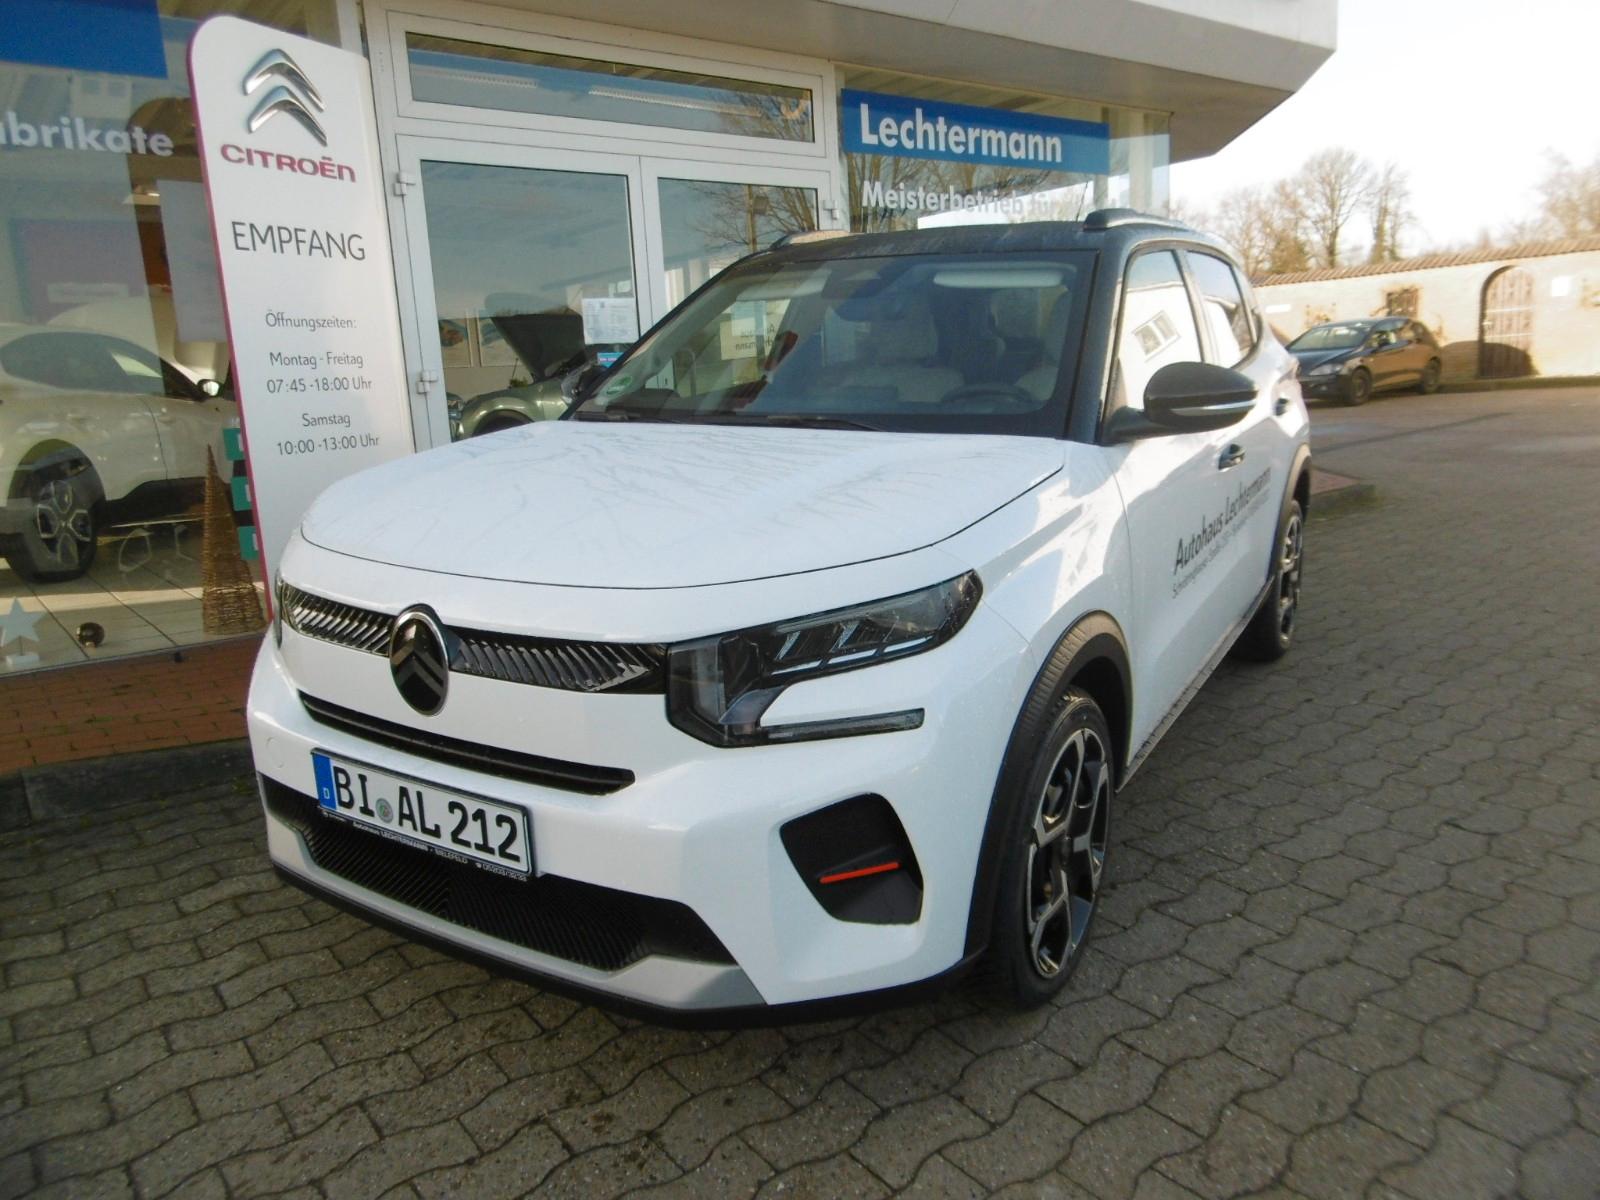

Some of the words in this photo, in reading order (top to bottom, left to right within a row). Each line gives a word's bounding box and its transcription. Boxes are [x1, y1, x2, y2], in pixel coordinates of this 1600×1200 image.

[0, 111, 175, 157] brikate
[860, 103, 1063, 163] Lechtermann
[862, 179, 1024, 215] Meisterbetrieb
[231, 220, 367, 262] EMPFANG
[265, 309, 357, 332] Öffnungszeiten:
[269, 351, 317, 370] Montag
[326, 351, 364, 369] Freitag
[352, 375, 373, 391] Uhr
[302, 412, 352, 428] Samstag
[360, 432, 380, 448] Uhr
[1173, 513, 1224, 575] Autohaus
[333, 765, 376, 818] BI
[398, 785, 442, 839] AL
[448, 800, 521, 863] 212
